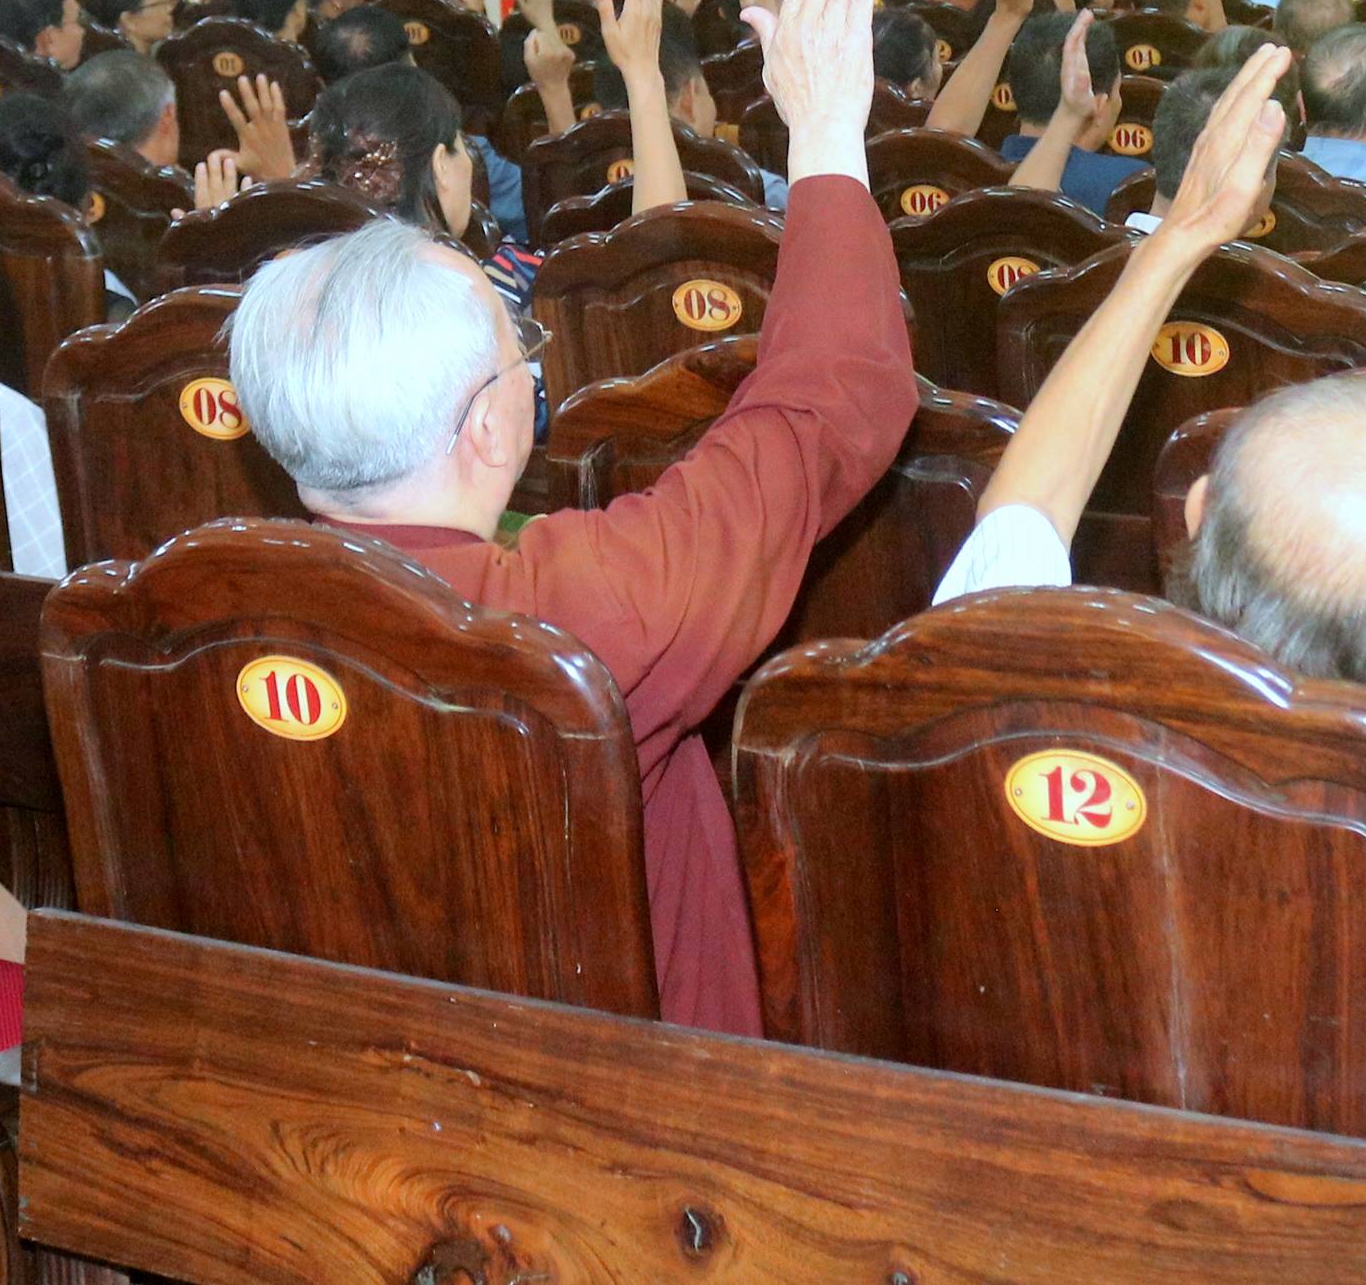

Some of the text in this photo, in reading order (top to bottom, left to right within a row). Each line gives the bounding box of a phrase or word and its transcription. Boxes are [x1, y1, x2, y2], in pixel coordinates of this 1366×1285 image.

[1115, 129, 1144, 149] 06
[684, 287, 734, 321] 08
[1168, 331, 1213, 366] 10
[193, 387, 242, 427] 08
[258, 670, 322, 726] 10
[1038, 760, 1114, 829] 12
